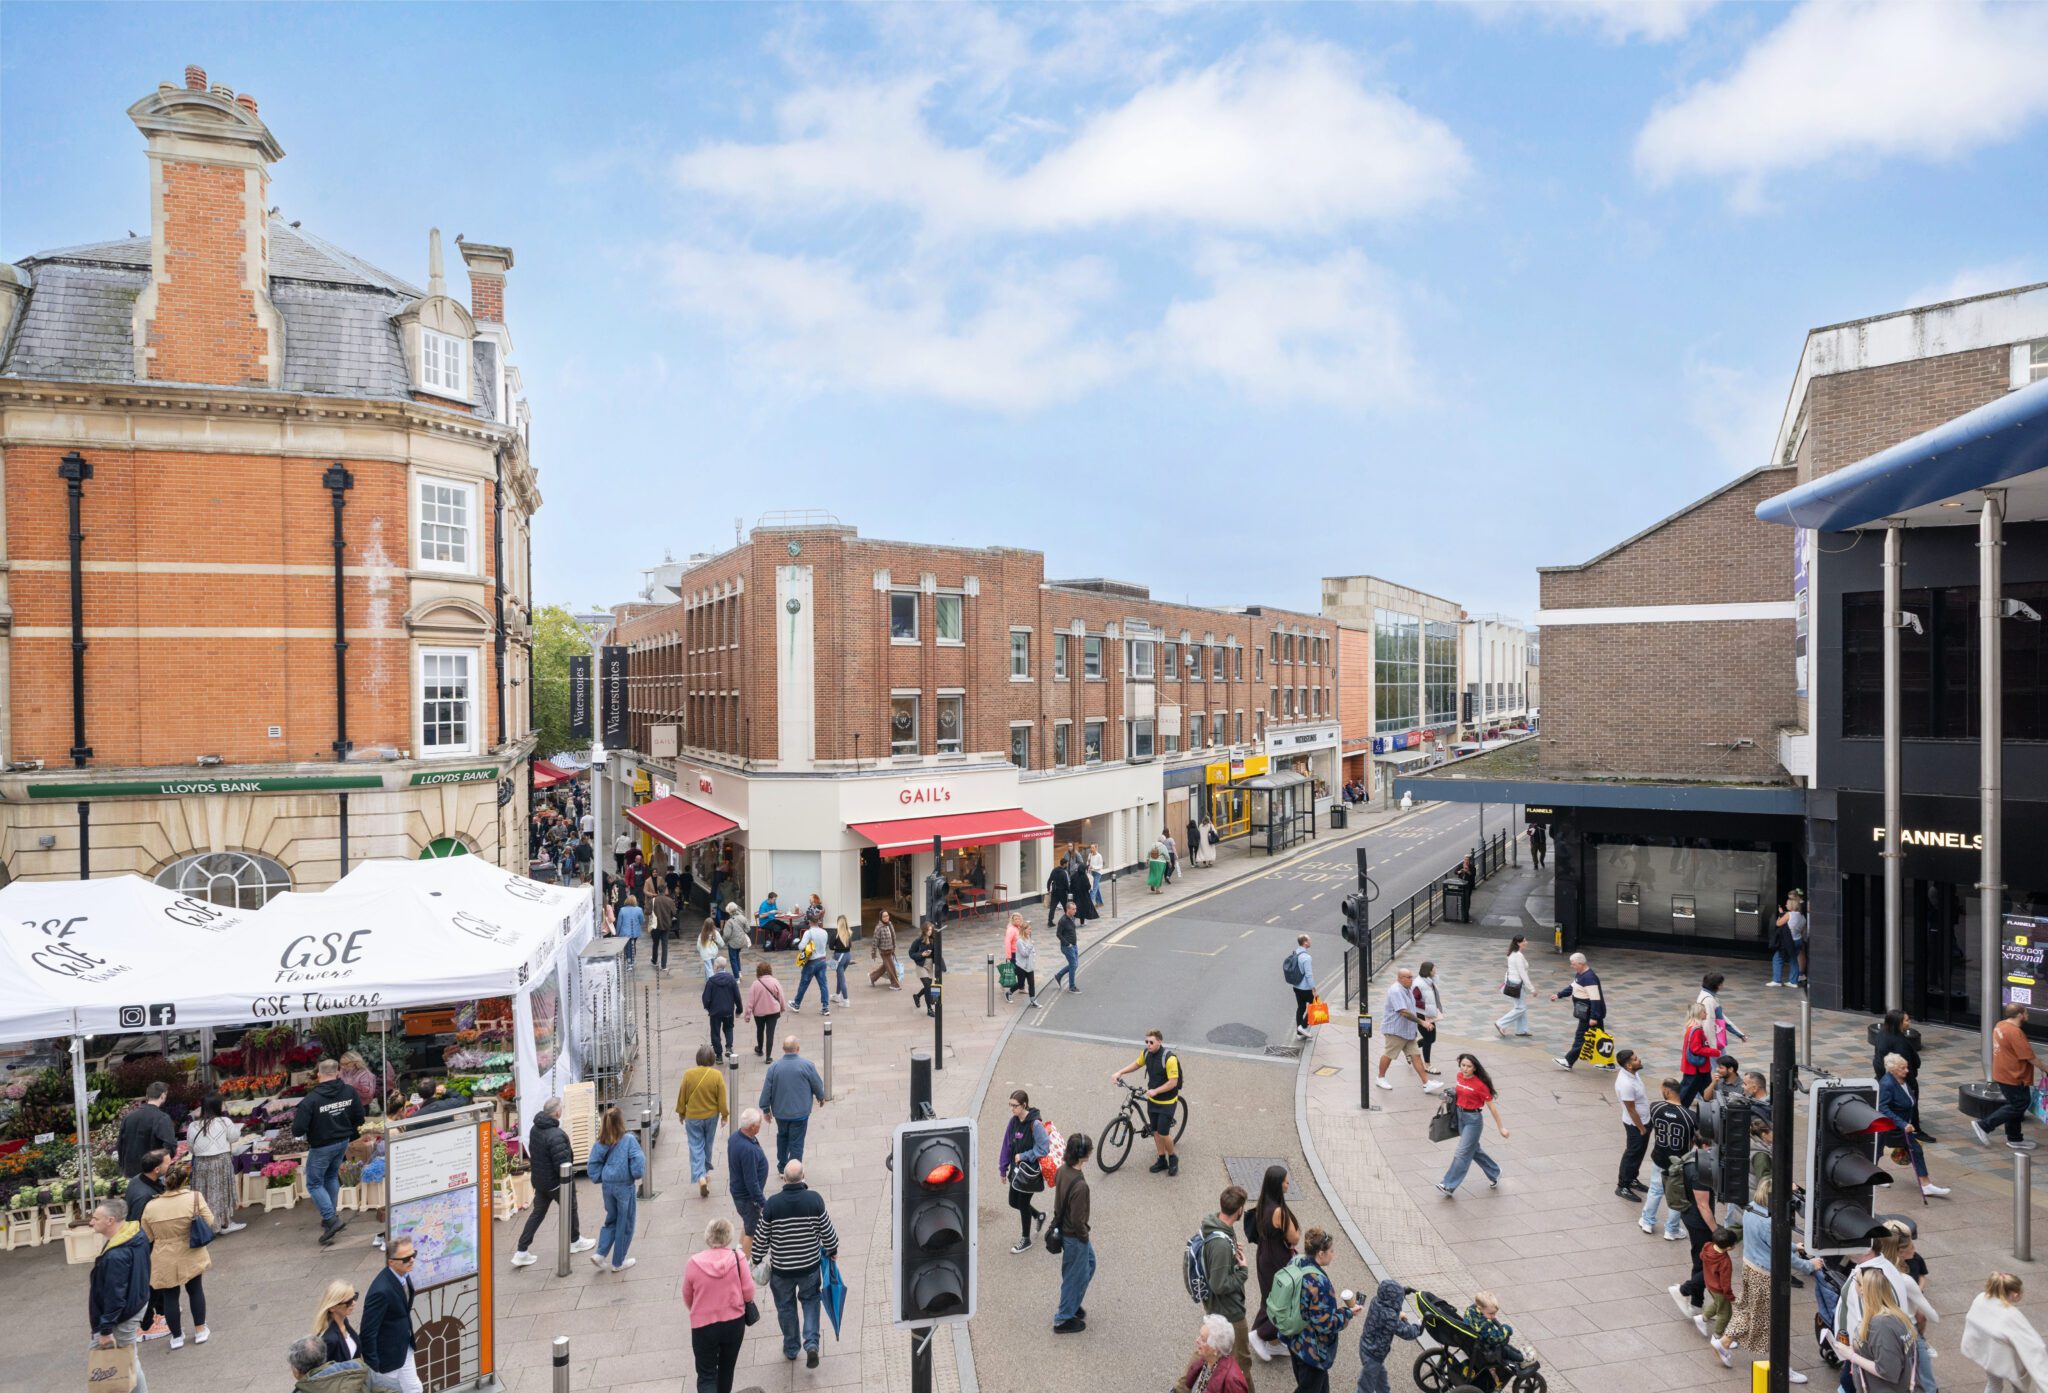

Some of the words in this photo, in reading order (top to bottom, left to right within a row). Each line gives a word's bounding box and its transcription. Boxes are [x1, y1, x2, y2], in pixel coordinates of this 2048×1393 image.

[574, 667, 584, 727] Waterstones
[608, 661, 620, 735] Waterstones
[420, 773, 462, 785] LLOYDS
[463, 770, 492, 781] BANK
[161, 783, 218, 794] LLOYDS
[221, 781, 262, 792] BANK
[899, 787, 951, 804] GAIL's
[1873, 827, 1982, 850] FANNELS
[1298, 861, 1357, 872] BUS
[1264, 871, 1349, 882] STOP
[2006, 920, 2036, 928] FLANNELS
[280, 929, 372, 969] GSE
[274, 969, 352, 983] Flowers
[252, 995, 291, 1017] GSE
[302, 992, 382, 1012] Flowers
[319, 1099, 353, 1113] REPRESENT
[1655, 1118, 1685, 1151] 38
